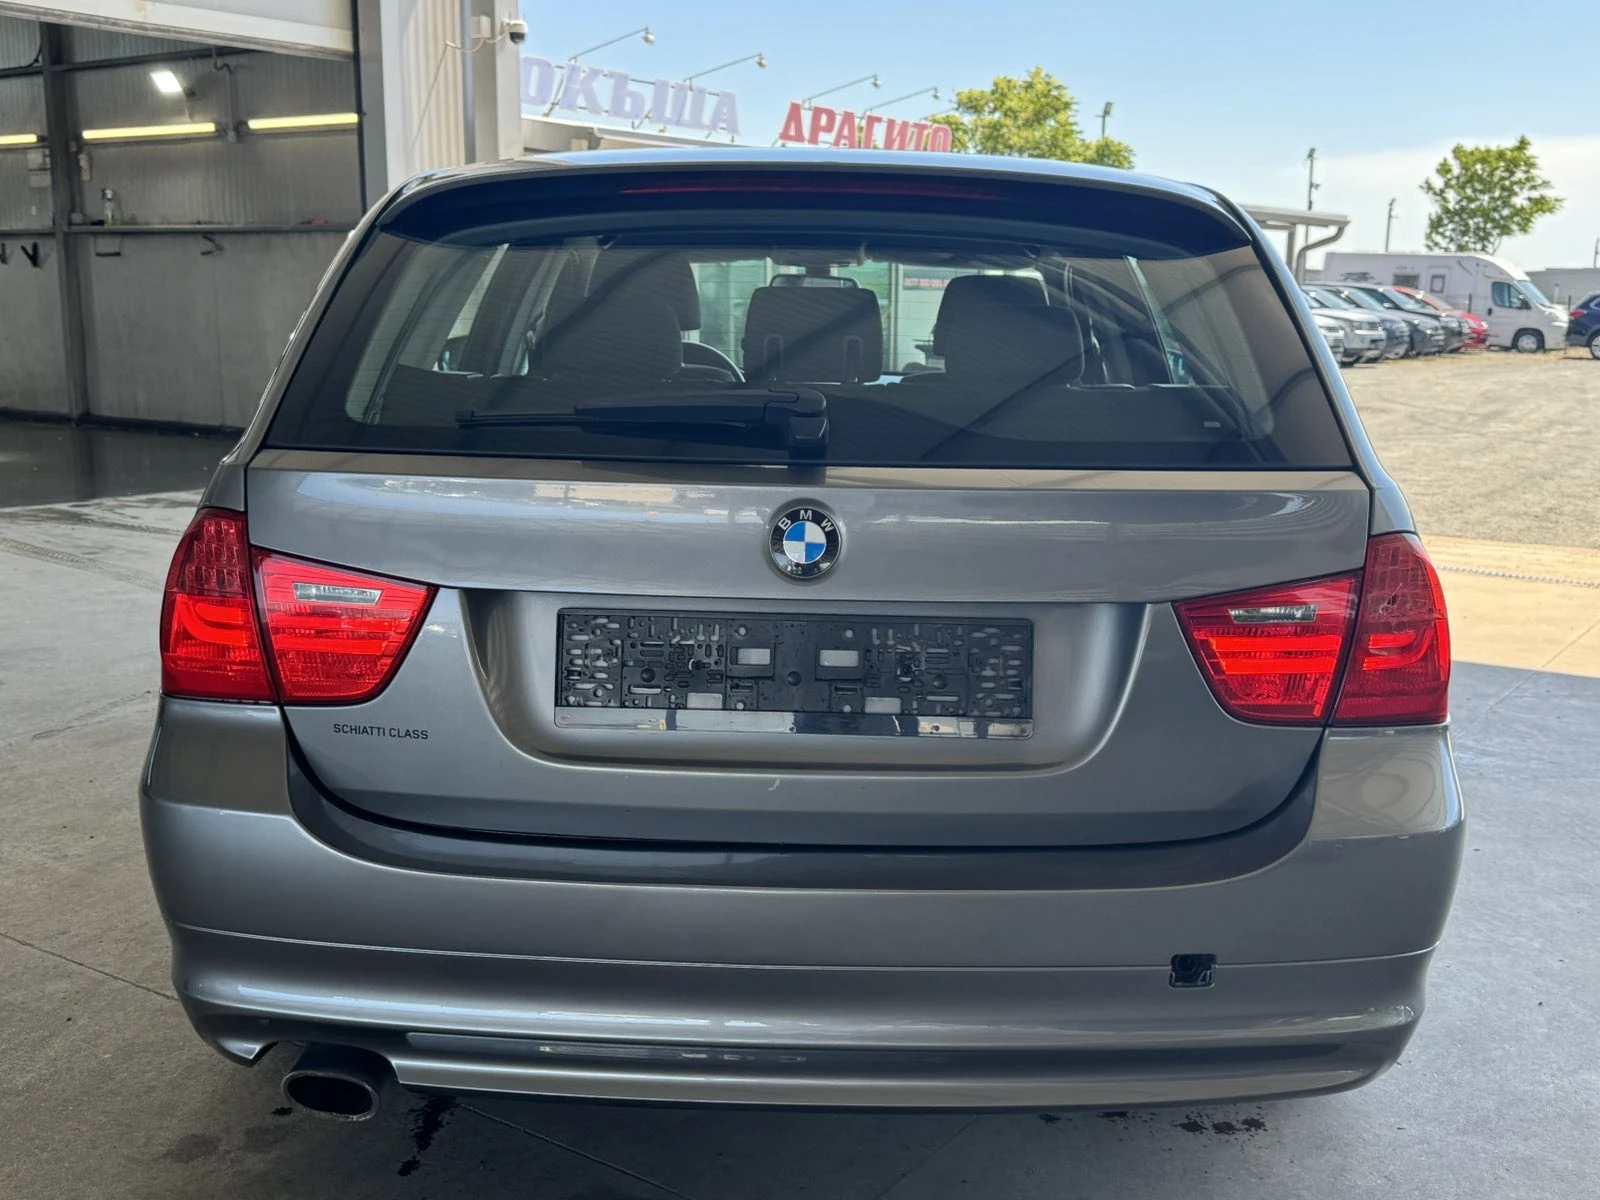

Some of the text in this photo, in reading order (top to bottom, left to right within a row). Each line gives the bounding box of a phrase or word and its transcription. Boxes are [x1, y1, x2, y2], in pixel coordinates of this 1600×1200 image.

[778, 101, 953, 153] ДРАГИТО
[778, 509, 834, 532] BMW
[333, 723, 429, 740] SCHIATTI CLASS
